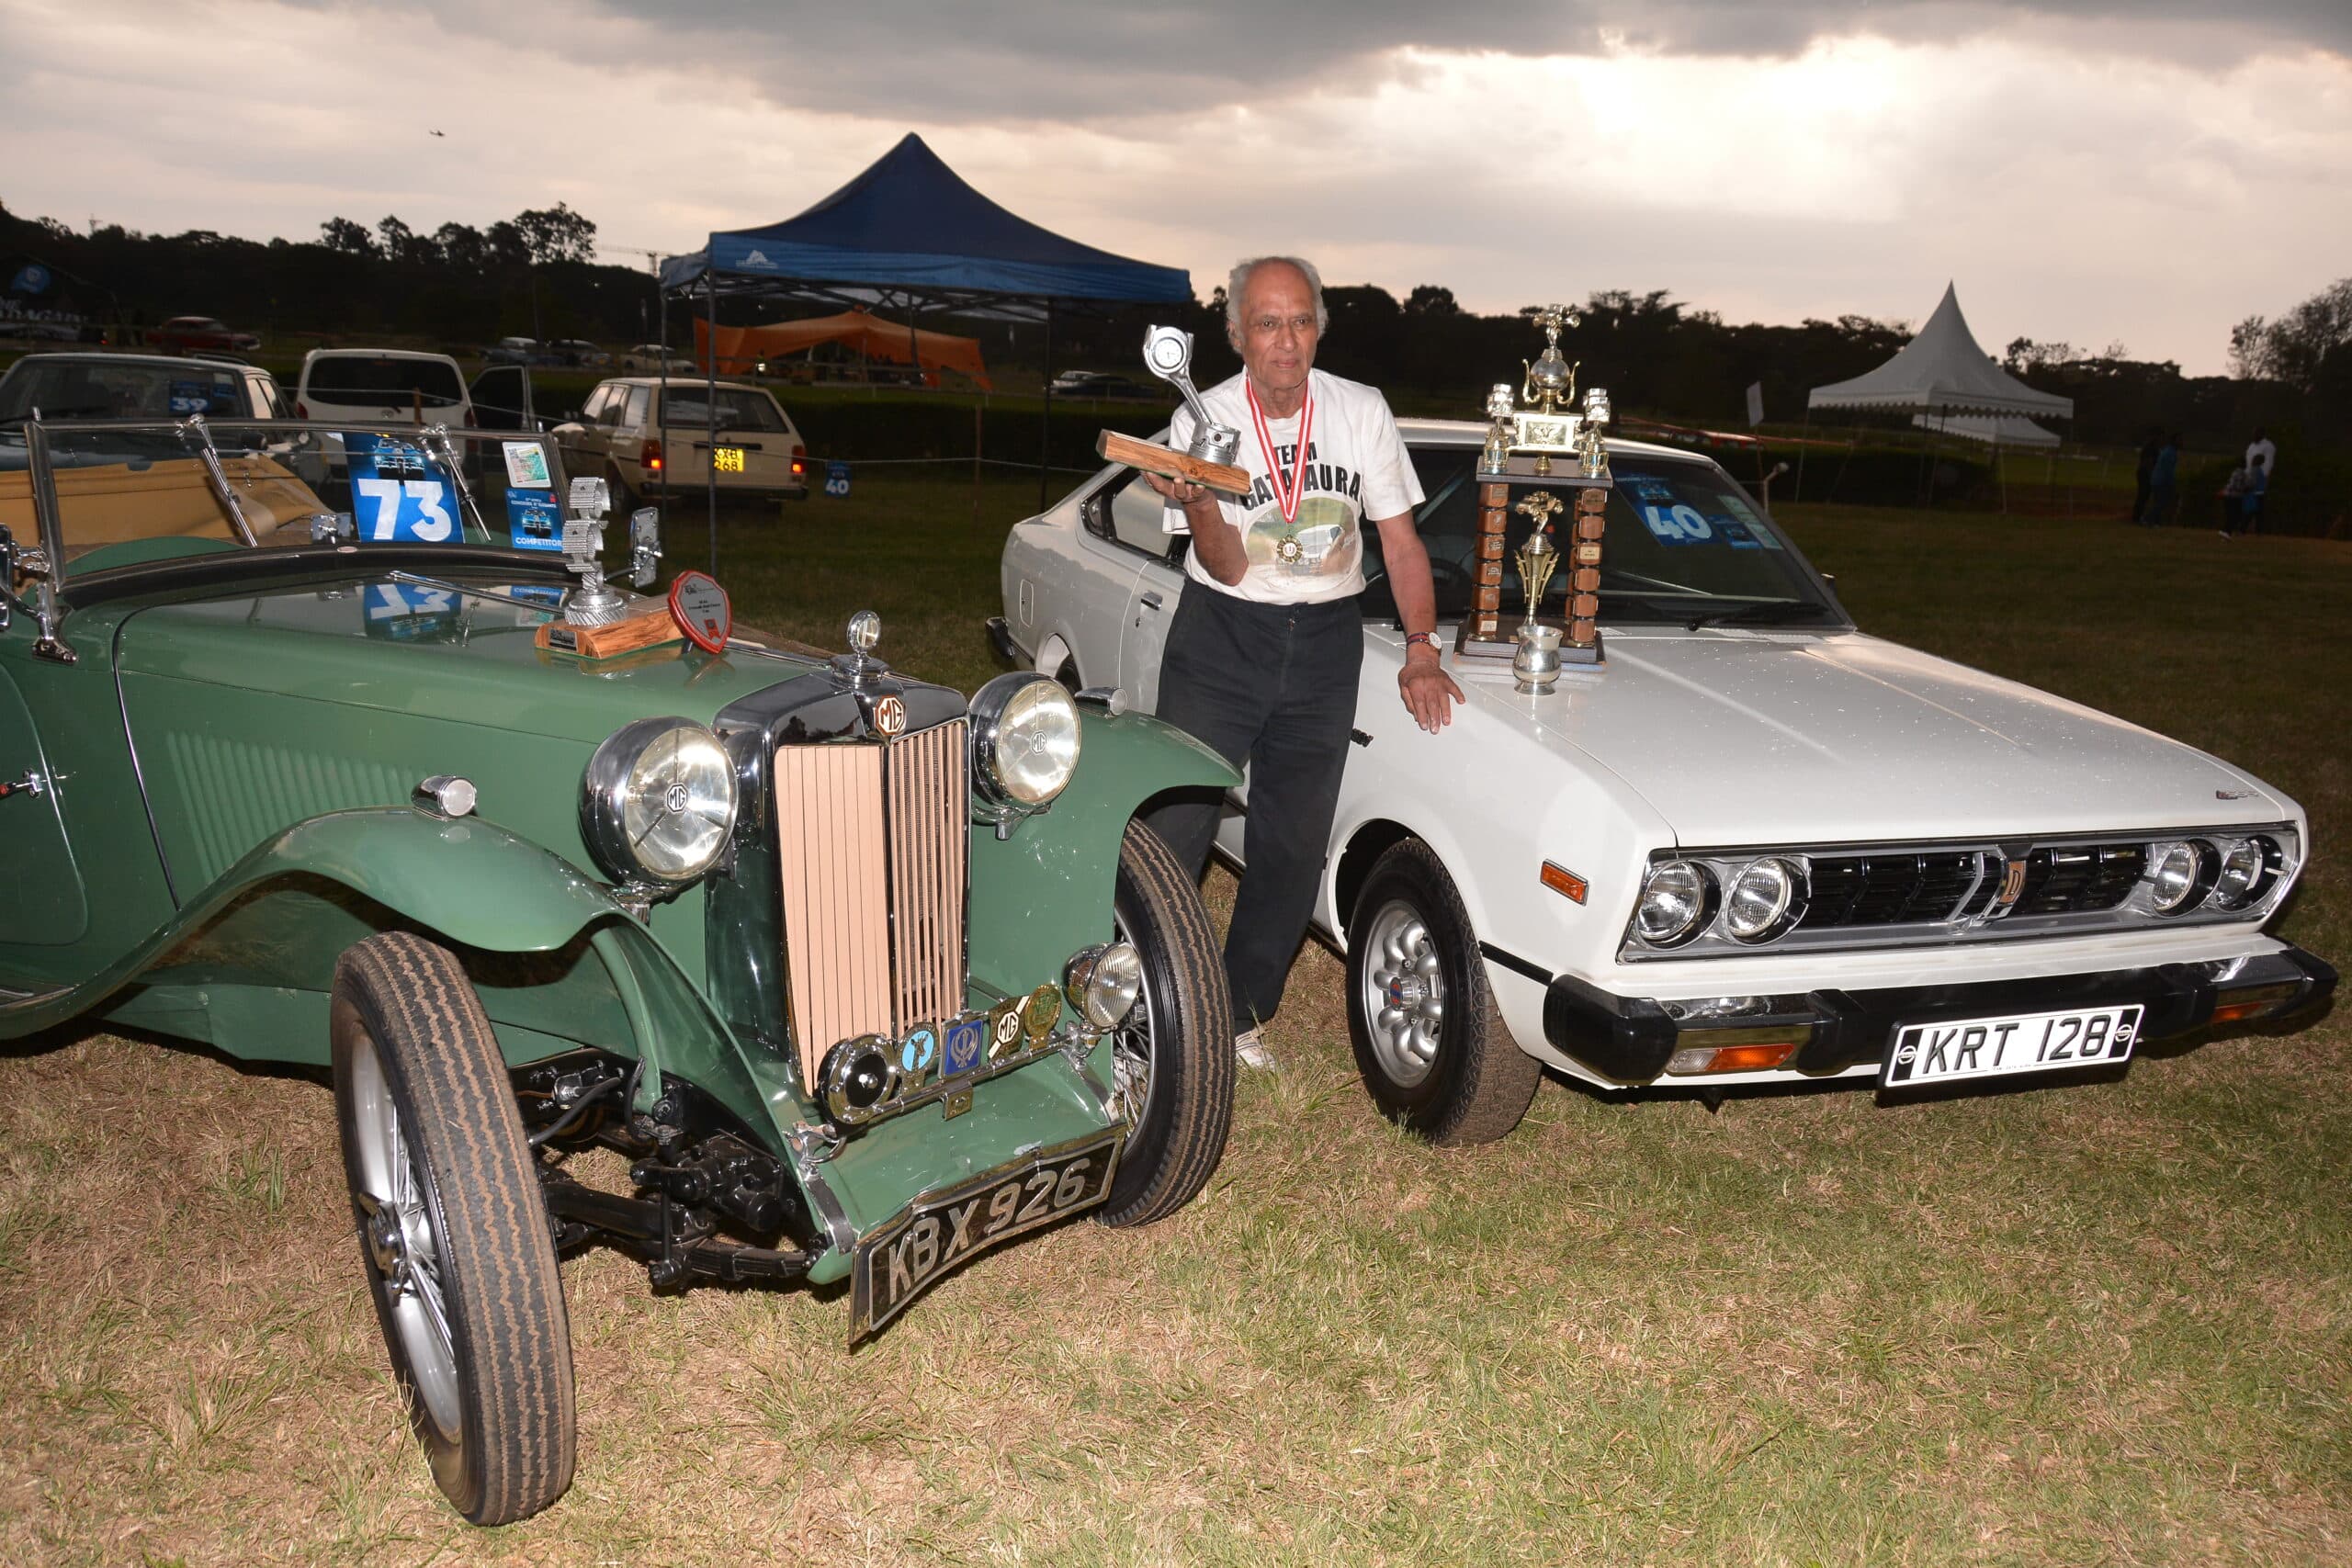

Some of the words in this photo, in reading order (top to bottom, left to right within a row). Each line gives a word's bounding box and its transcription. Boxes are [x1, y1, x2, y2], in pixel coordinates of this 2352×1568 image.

[714, 460, 739, 471] 268
[825, 479, 850, 494] 40
[357, 479, 452, 542] 73
[1645, 504, 1713, 539] 40
[514, 536, 562, 547] COMPETITOR
[879, 699, 903, 731] MG
[1033, 734, 1046, 751] MG
[669, 788, 685, 808] MG
[1000, 1014, 1017, 1040] MG
[1923, 1022, 2019, 1075] KRT
[2036, 1014, 2111, 1062] 128
[888, 1198, 980, 1305] KBX
[983, 1157, 1091, 1235] 926
